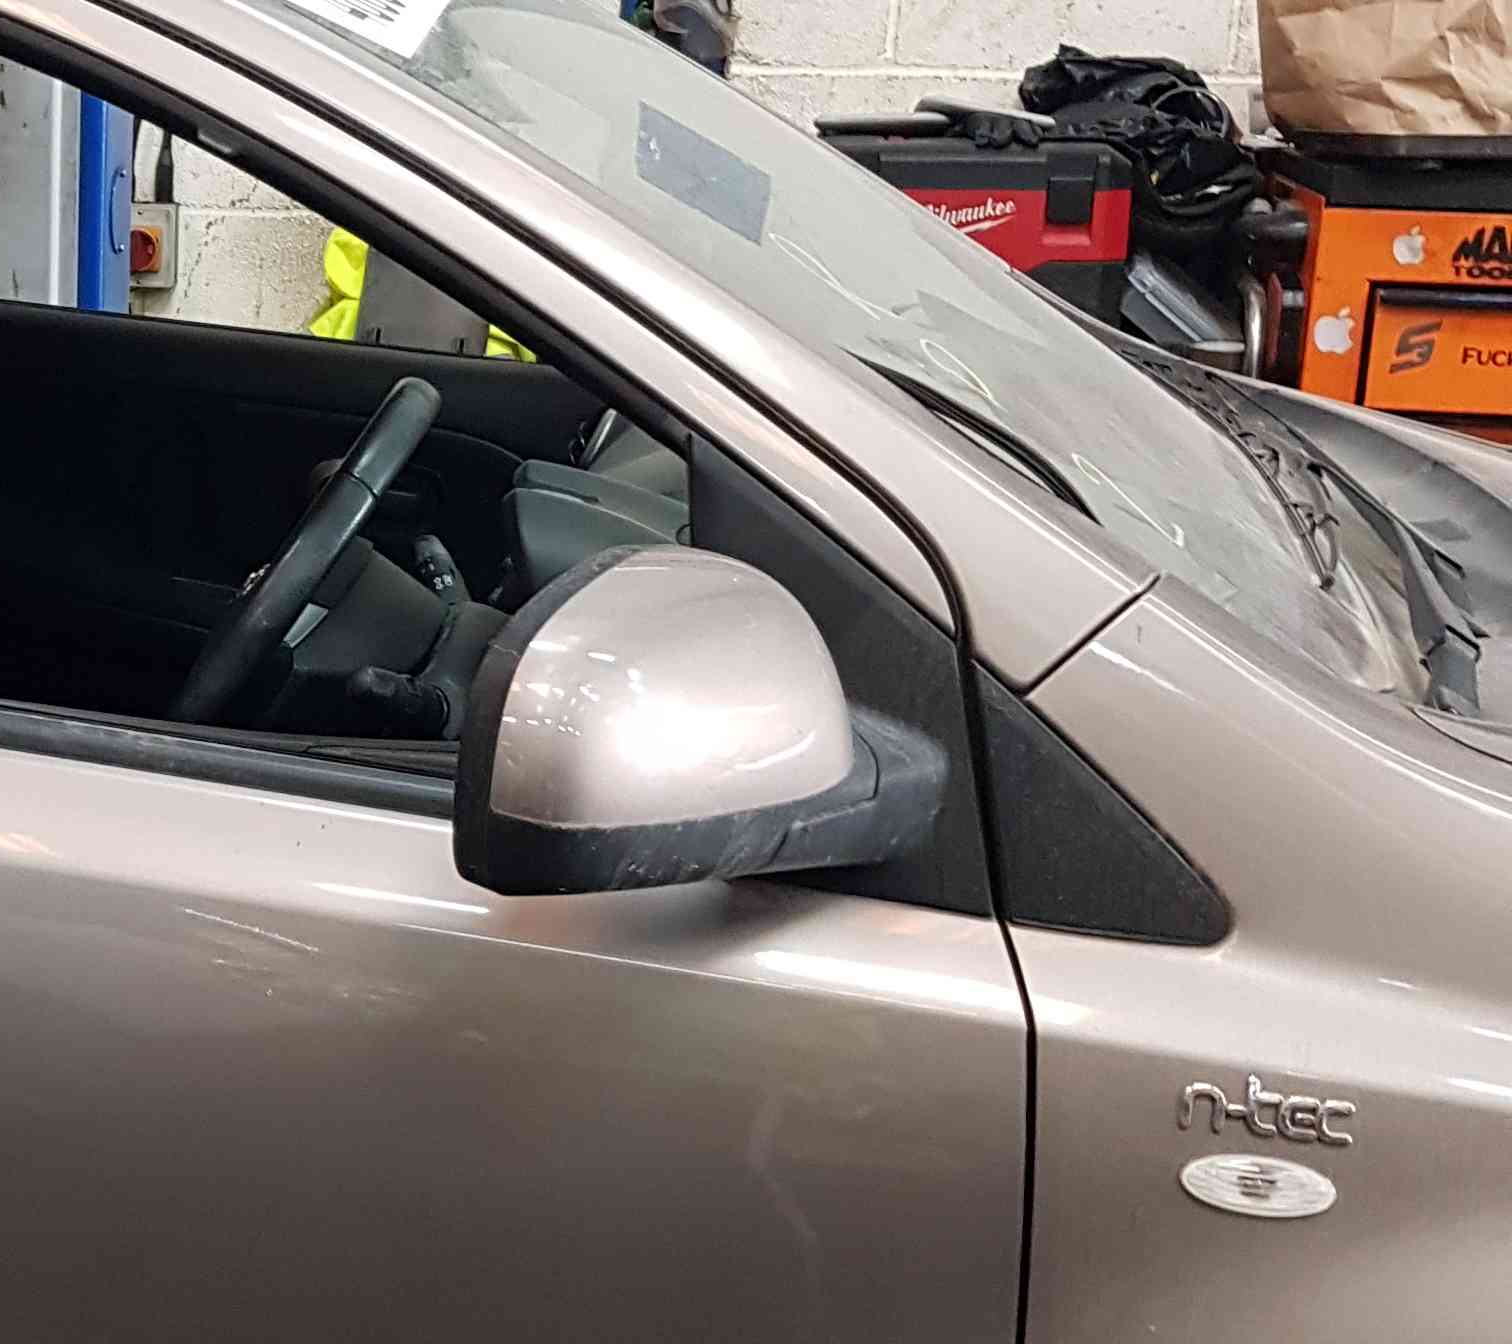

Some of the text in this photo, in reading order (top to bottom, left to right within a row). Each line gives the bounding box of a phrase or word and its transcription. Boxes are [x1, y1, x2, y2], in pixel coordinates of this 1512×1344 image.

[927, 197, 1017, 226] lwaukee
[1453, 225, 1512, 264] MA
[1178, 1073, 1356, 1147] n-tec
